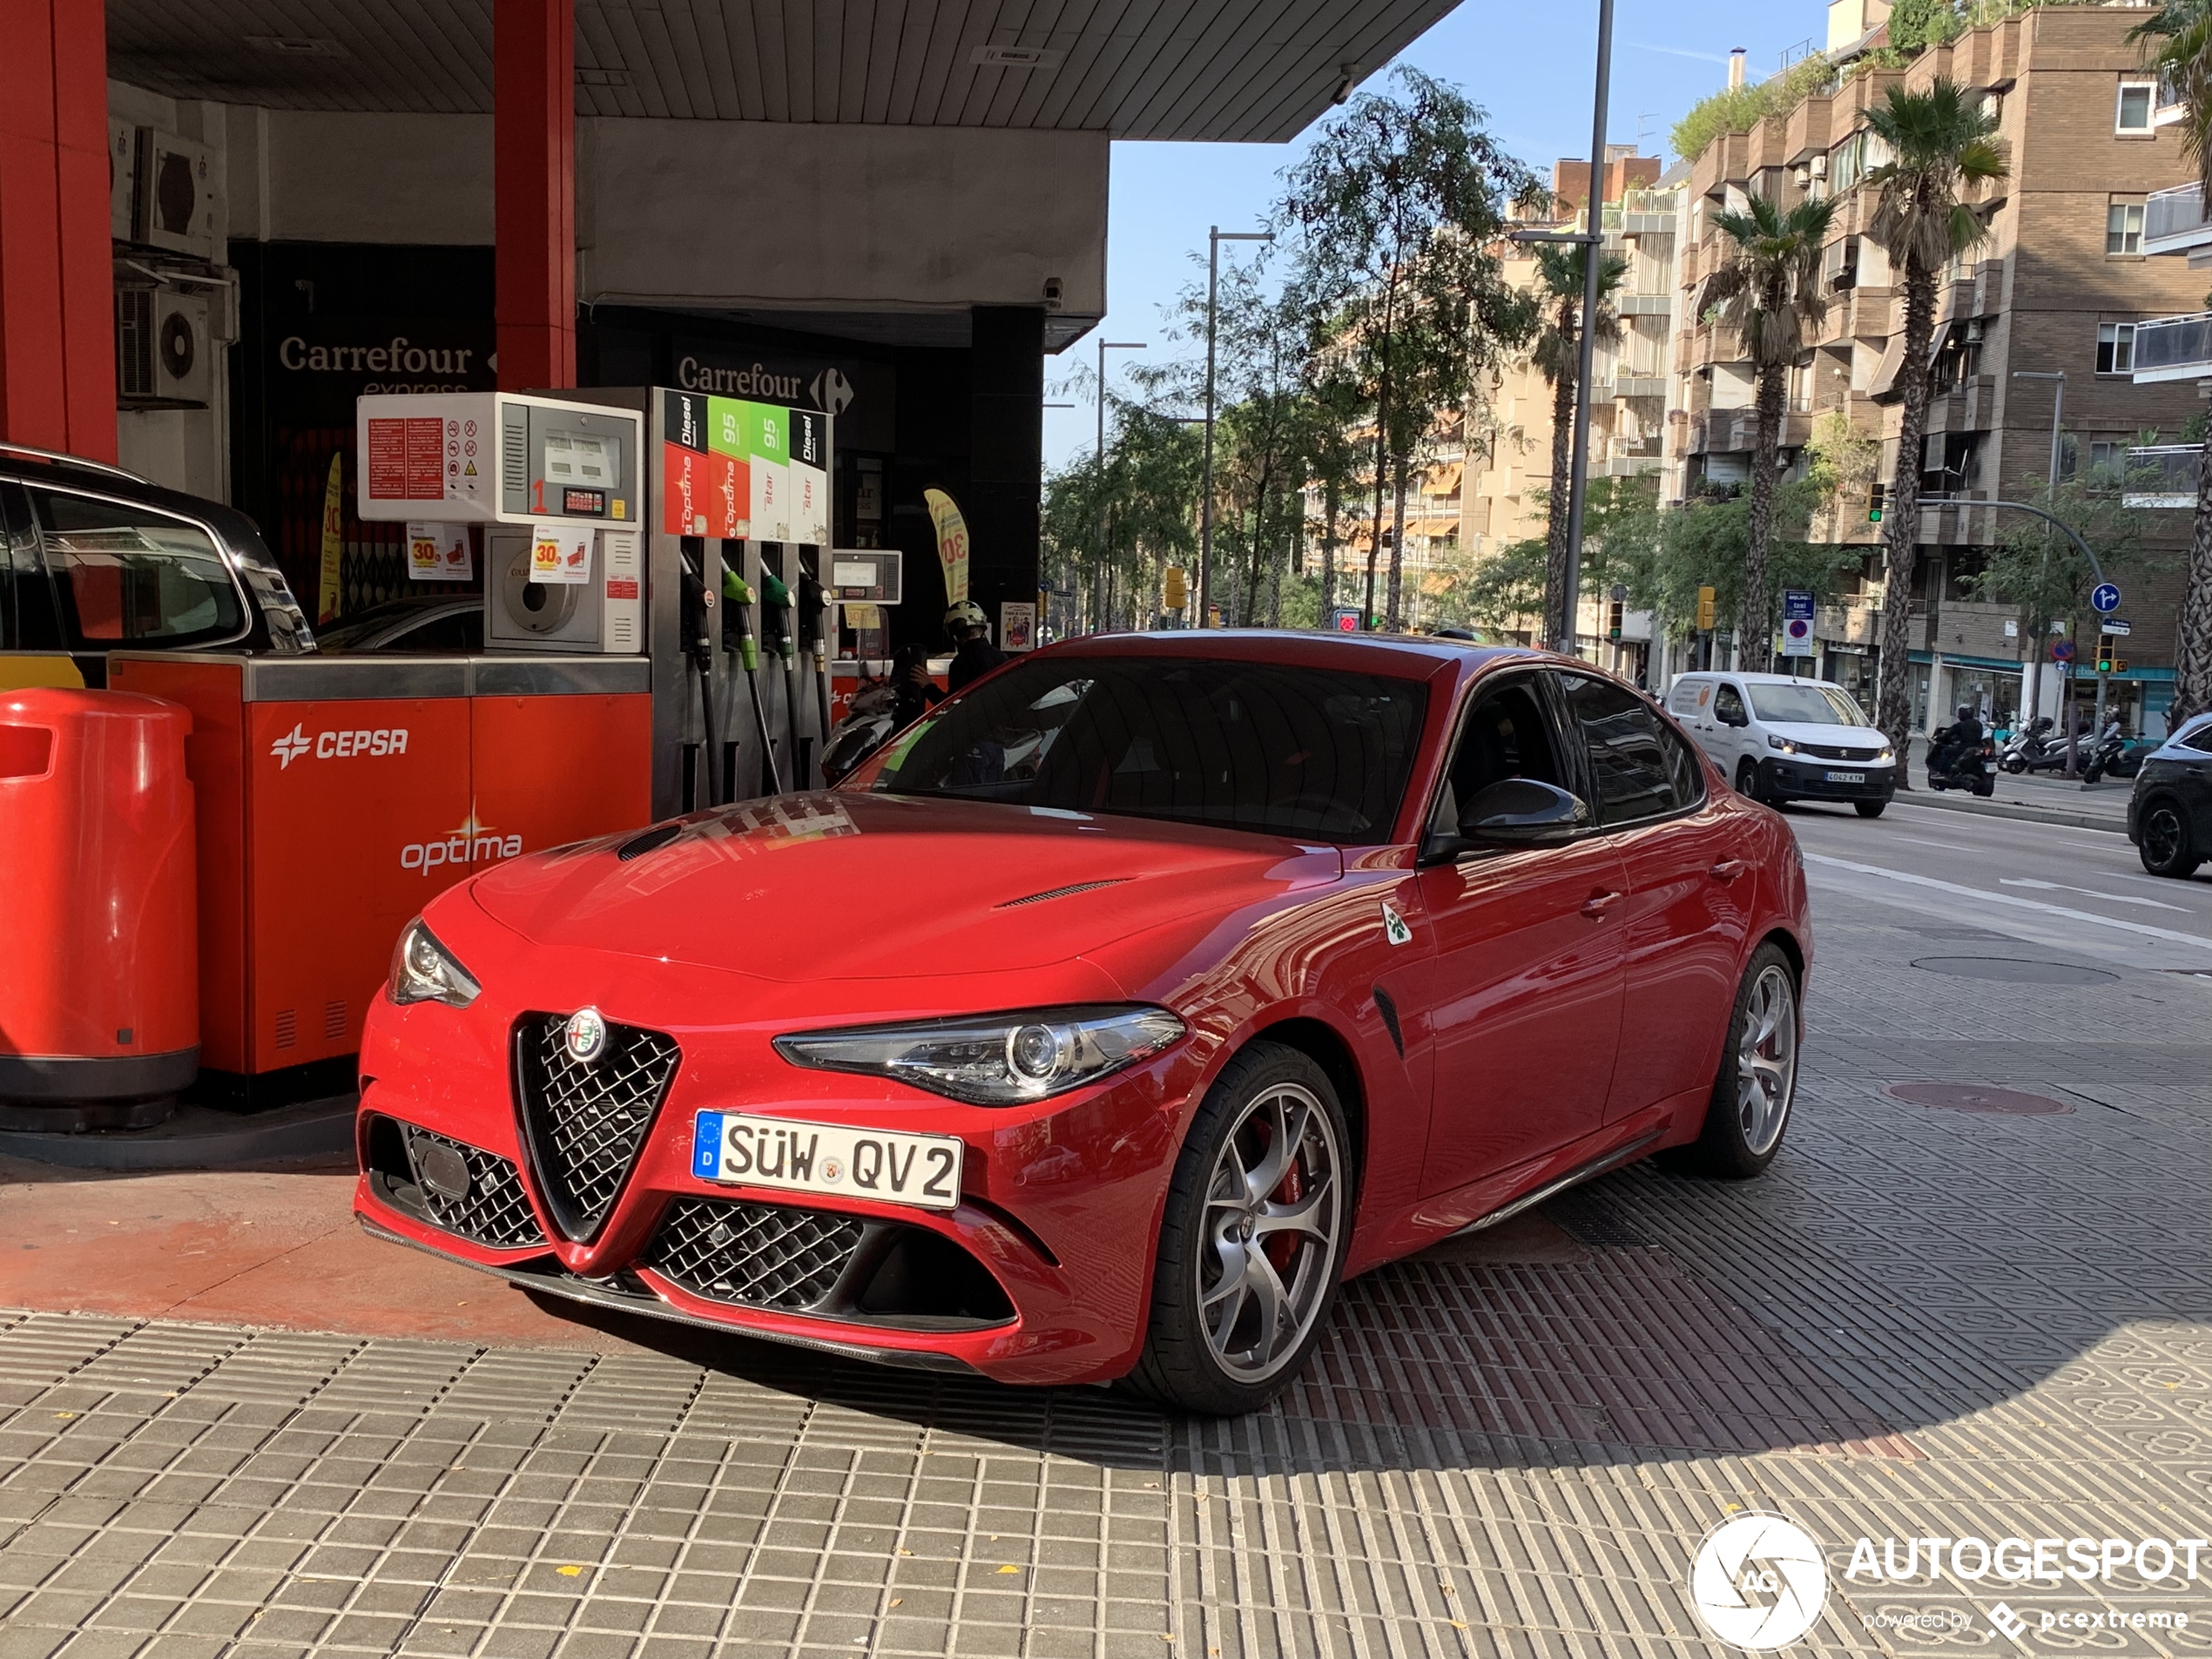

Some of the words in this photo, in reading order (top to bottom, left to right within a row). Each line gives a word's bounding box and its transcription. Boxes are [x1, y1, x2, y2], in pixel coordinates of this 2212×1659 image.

[280, 336, 473, 374] Carrefour
[678, 355, 802, 400] Carrefour
[681, 395, 692, 446] Diesel
[723, 412, 736, 445] 95
[764, 417, 776, 449] 95
[803, 415, 812, 462] Diesel
[532, 478, 548, 513] 1
[683, 455, 694, 523] optima
[726, 460, 737, 525] optima
[765, 472, 773, 505] star
[413, 543, 435, 560] 30
[536, 544, 556, 563] 30
[847, 611, 860, 622] 30
[316, 729, 408, 759] CEPSA
[401, 833, 523, 877] optima
[702, 1151, 712, 1166] D
